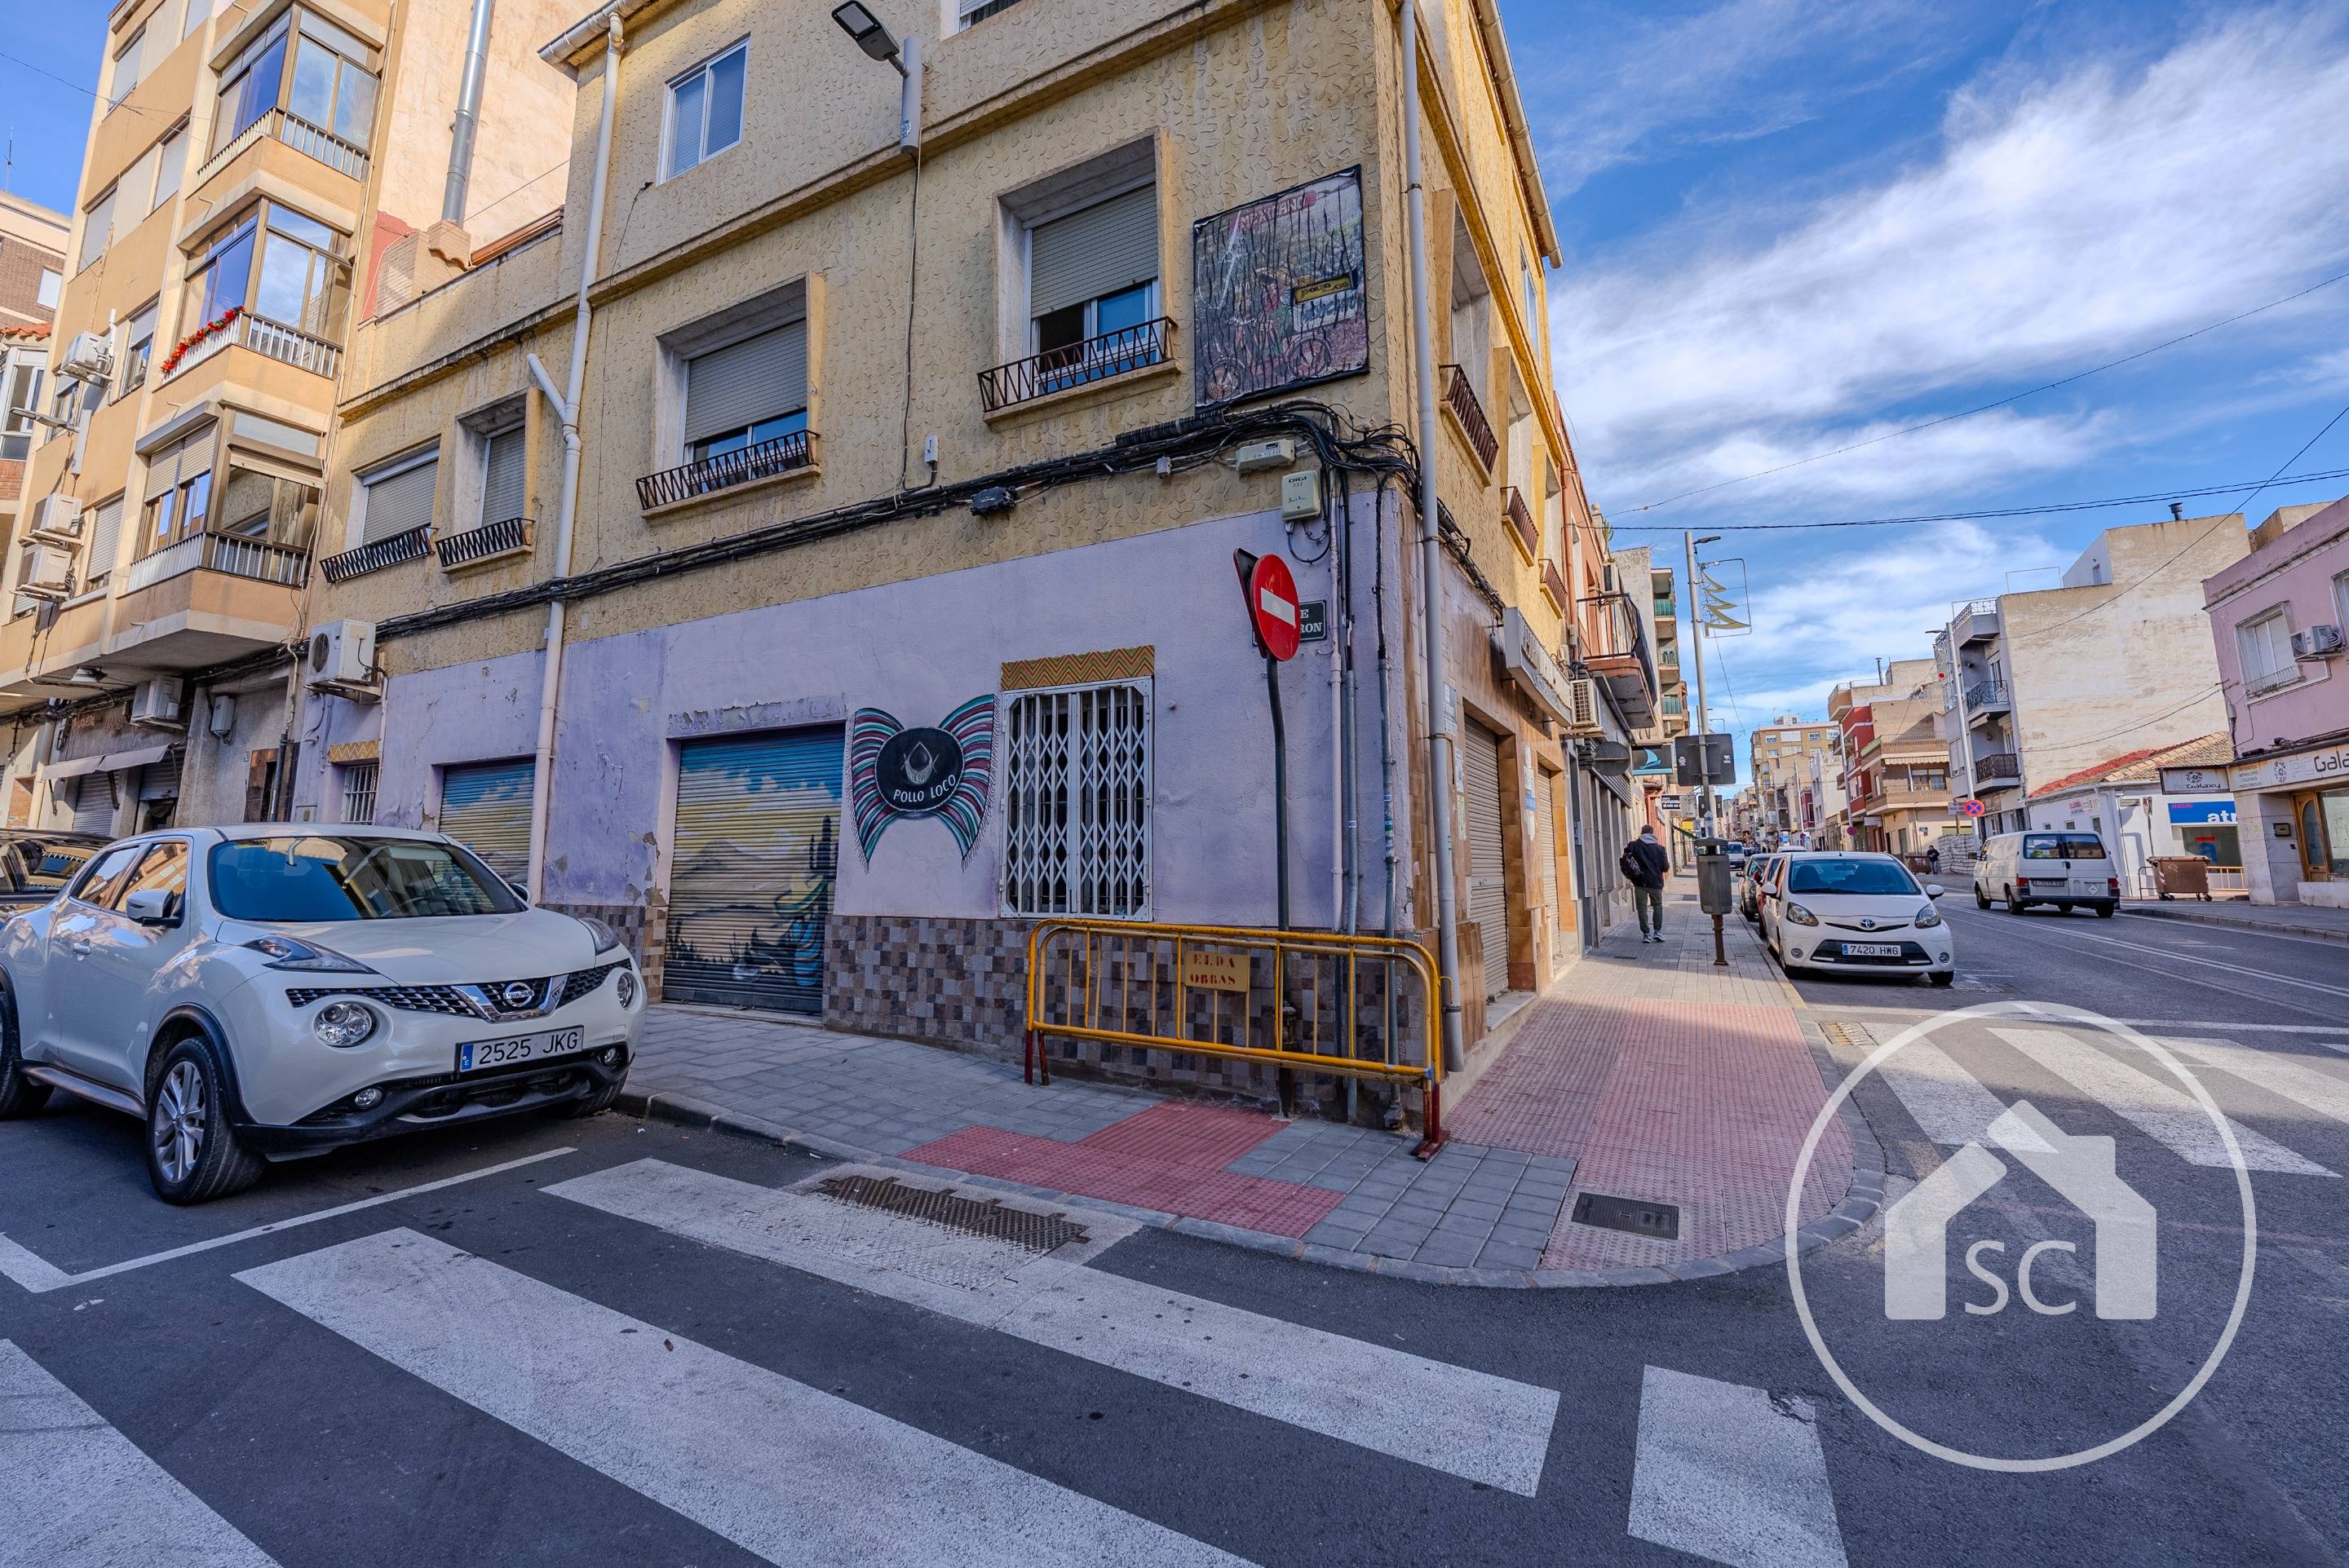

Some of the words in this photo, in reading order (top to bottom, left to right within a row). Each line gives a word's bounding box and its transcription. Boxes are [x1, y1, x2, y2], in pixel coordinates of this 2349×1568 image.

[1300, 622, 1323, 634] RON
[893, 789, 924, 803] POLLO
[931, 774, 957, 799] LOCO
[1851, 946, 1875, 954] 7420
[1880, 947, 1898, 955] HWG
[1193, 953, 1235, 968] ELDA
[1189, 974, 1236, 985] OBRAS
[479, 1039, 531, 1065] 2525
[542, 1031, 578, 1053] JKG
